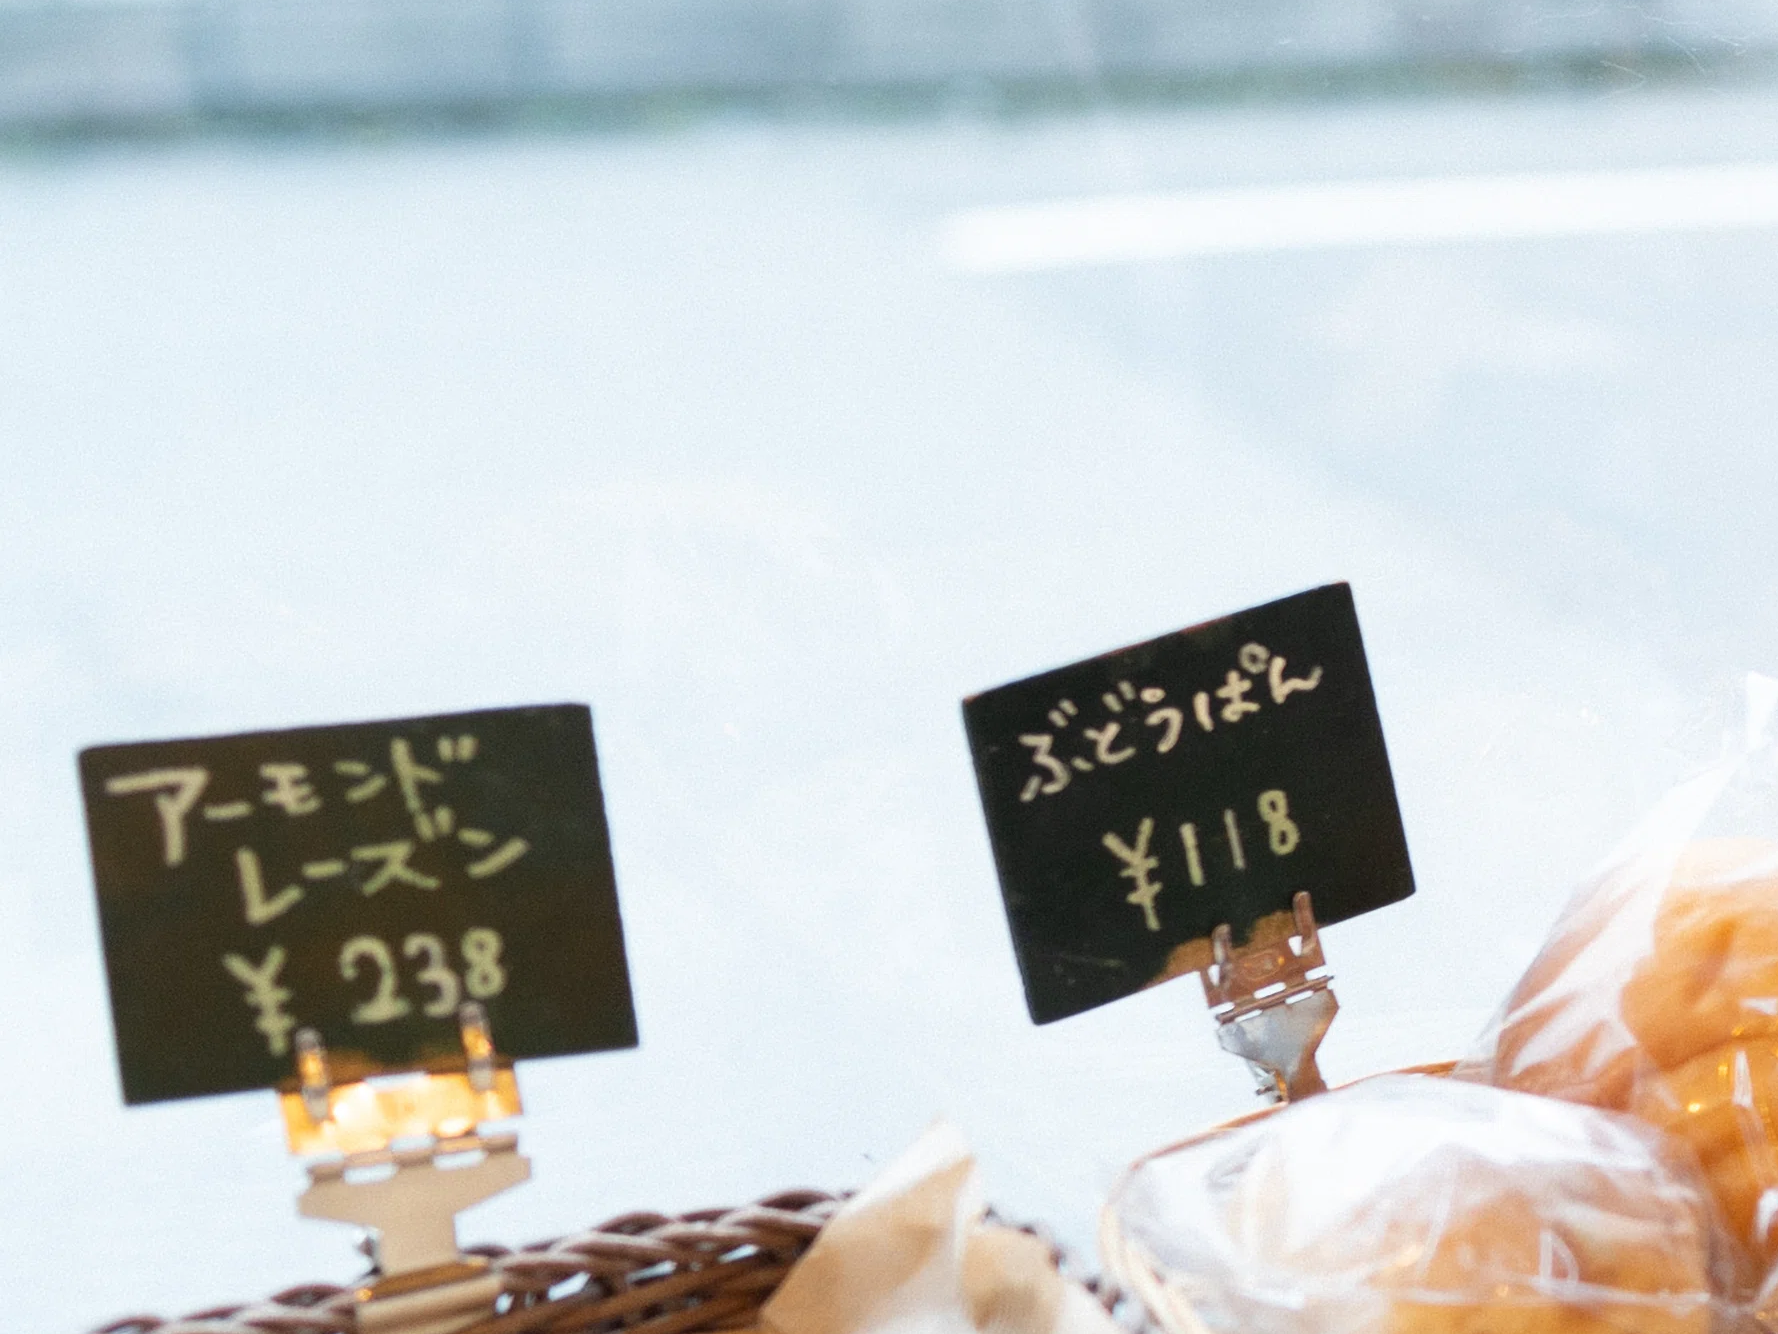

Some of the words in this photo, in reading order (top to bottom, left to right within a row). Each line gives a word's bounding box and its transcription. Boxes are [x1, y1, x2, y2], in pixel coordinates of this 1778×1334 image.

[1018, 641, 1324, 802] ぶどうぱん
[104, 733, 480, 866] アーモンド
[236, 805, 530, 927] レーズン
[1102, 789, 1300, 932] ¥118
[222, 927, 507, 1057] ¥238
